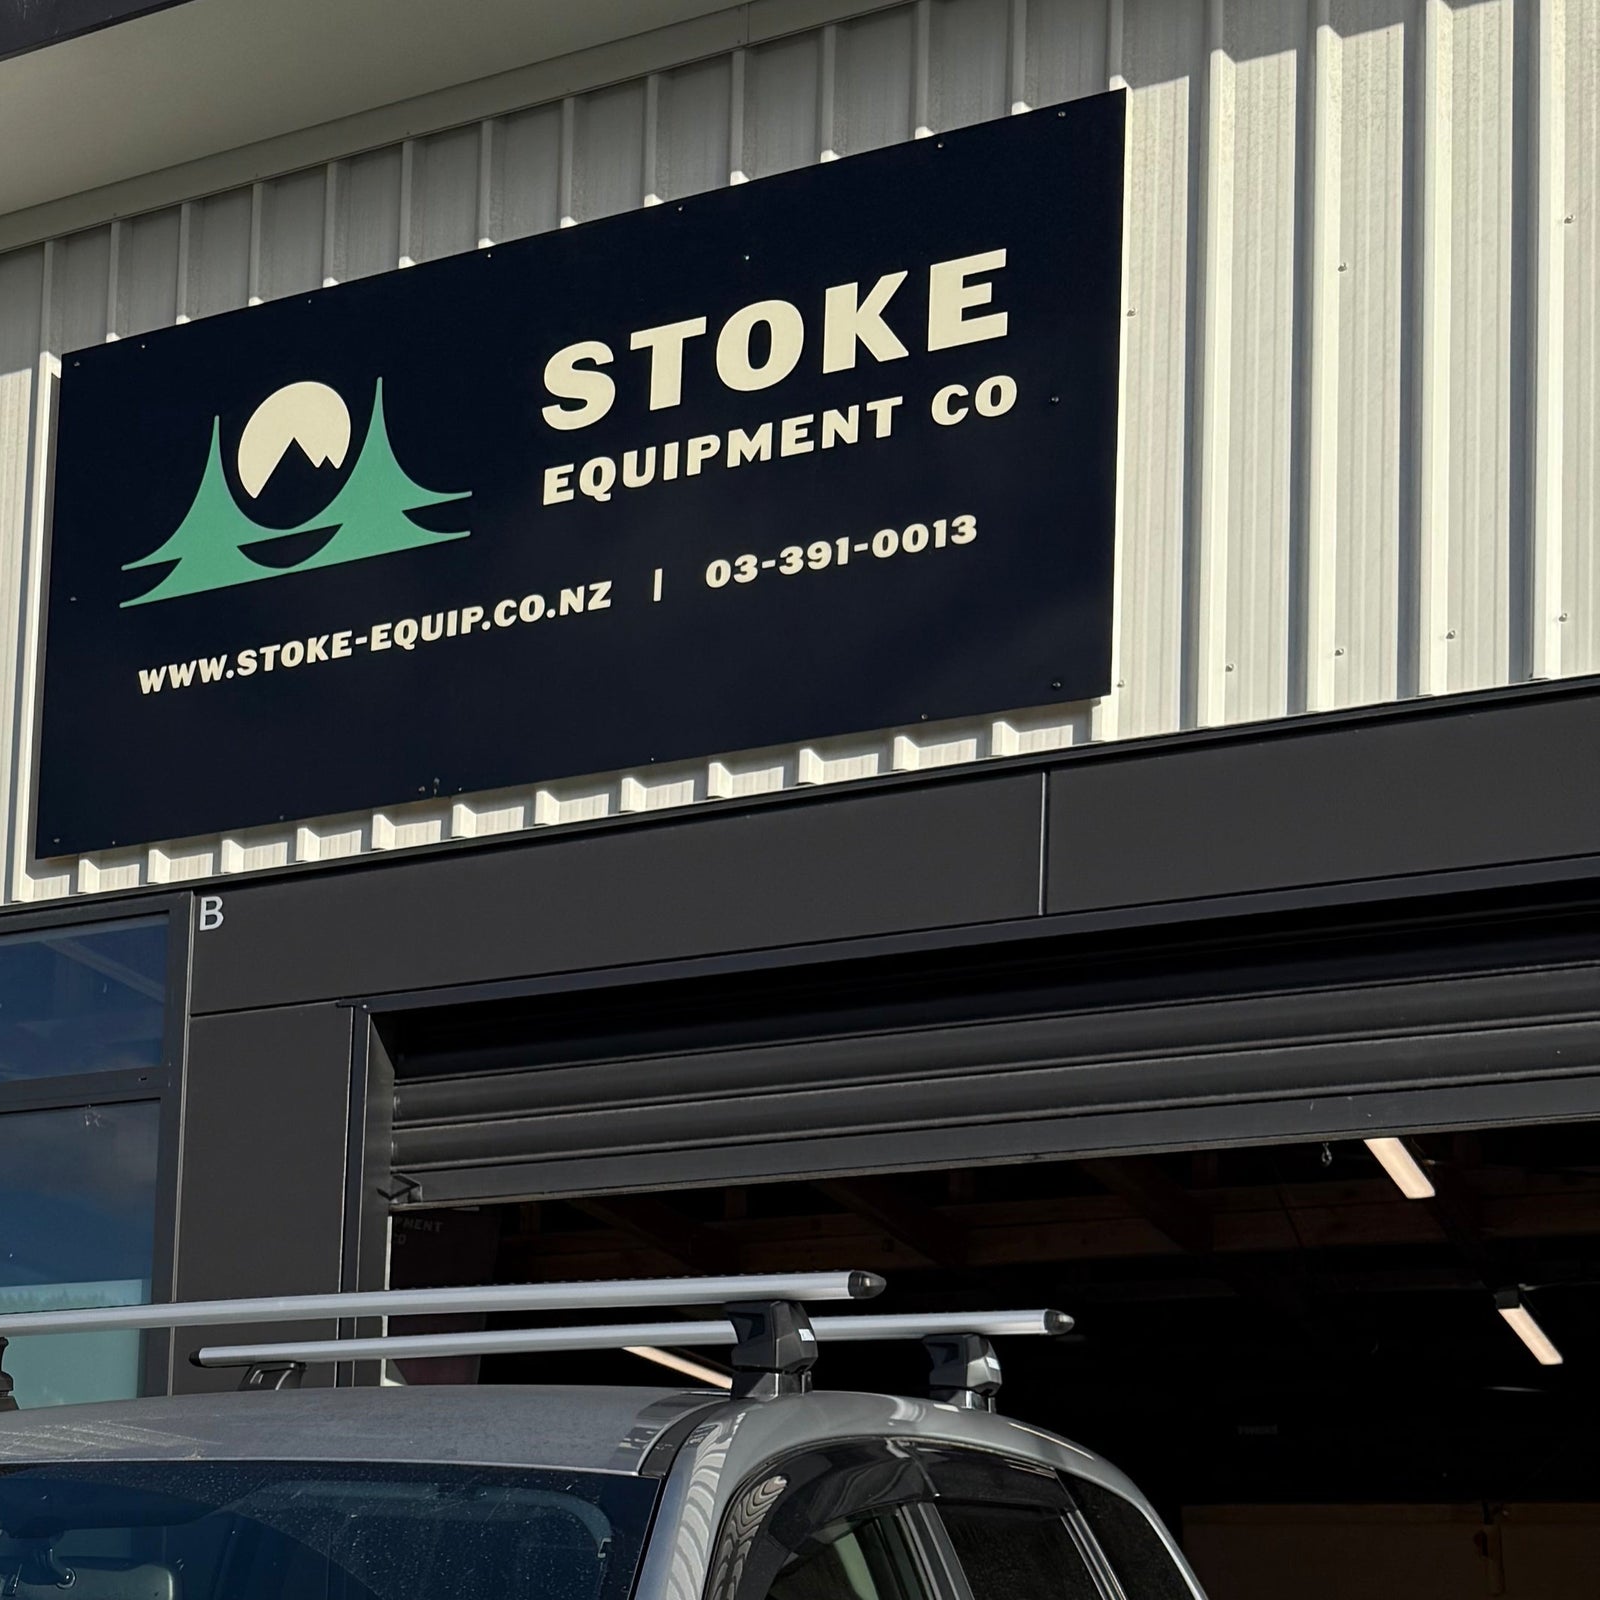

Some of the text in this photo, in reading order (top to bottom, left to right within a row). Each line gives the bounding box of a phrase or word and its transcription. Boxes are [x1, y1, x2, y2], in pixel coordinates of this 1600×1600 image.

[542, 248, 1009, 431] STOKE
[542, 375, 1018, 506] EQUIPMENT CO
[138, 580, 612, 695] WWW.STOKE-EQUIP.CO.NZ
[705, 514, 977, 588] 03-391-0013
[199, 895, 225, 931] B
